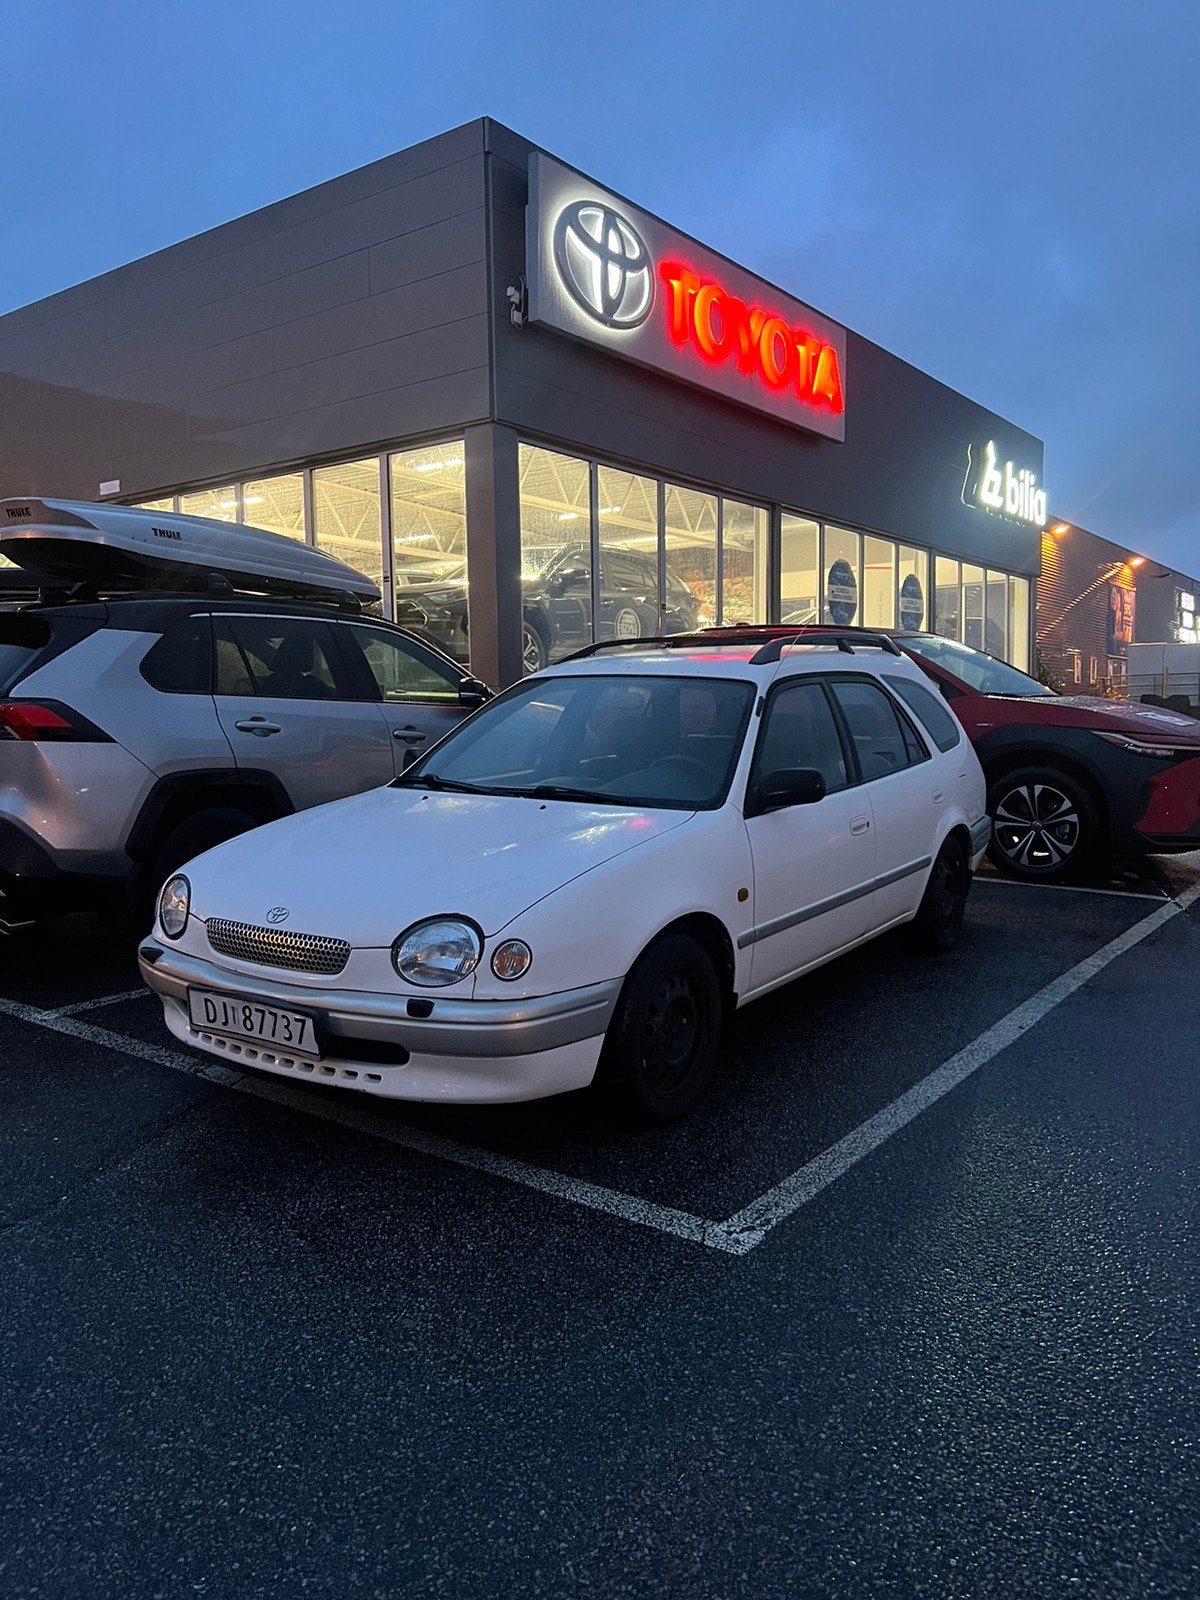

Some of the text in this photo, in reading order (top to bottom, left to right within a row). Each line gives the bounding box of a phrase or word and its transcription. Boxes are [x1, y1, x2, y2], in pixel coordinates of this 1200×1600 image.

[659, 259, 845, 414] TOYOTA
[5, 507, 32, 518] THULE
[1005, 460, 1047, 527] bilia
[151, 527, 182, 541] THULE
[203, 997, 307, 1045] DJ 87737
